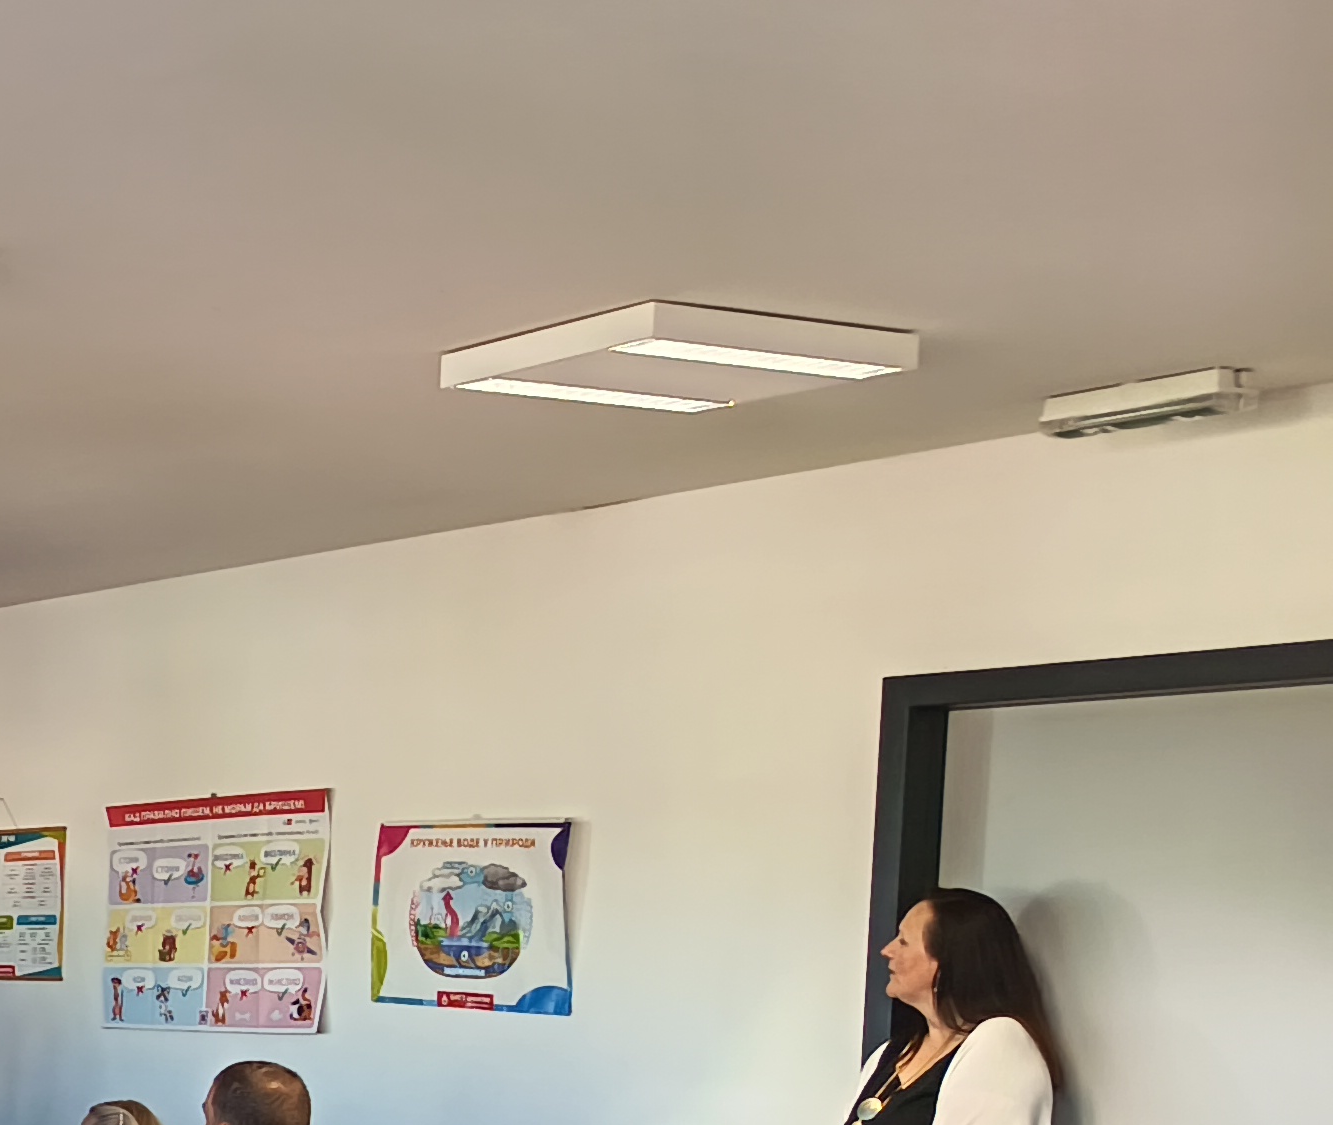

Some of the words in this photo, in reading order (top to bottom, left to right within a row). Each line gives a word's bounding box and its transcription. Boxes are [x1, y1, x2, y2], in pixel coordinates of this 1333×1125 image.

[410, 838, 454, 848] КРУЖЕЊЕ
[457, 838, 480, 848] ВОДЕ
[491, 838, 536, 849] ПРИРОДИ
